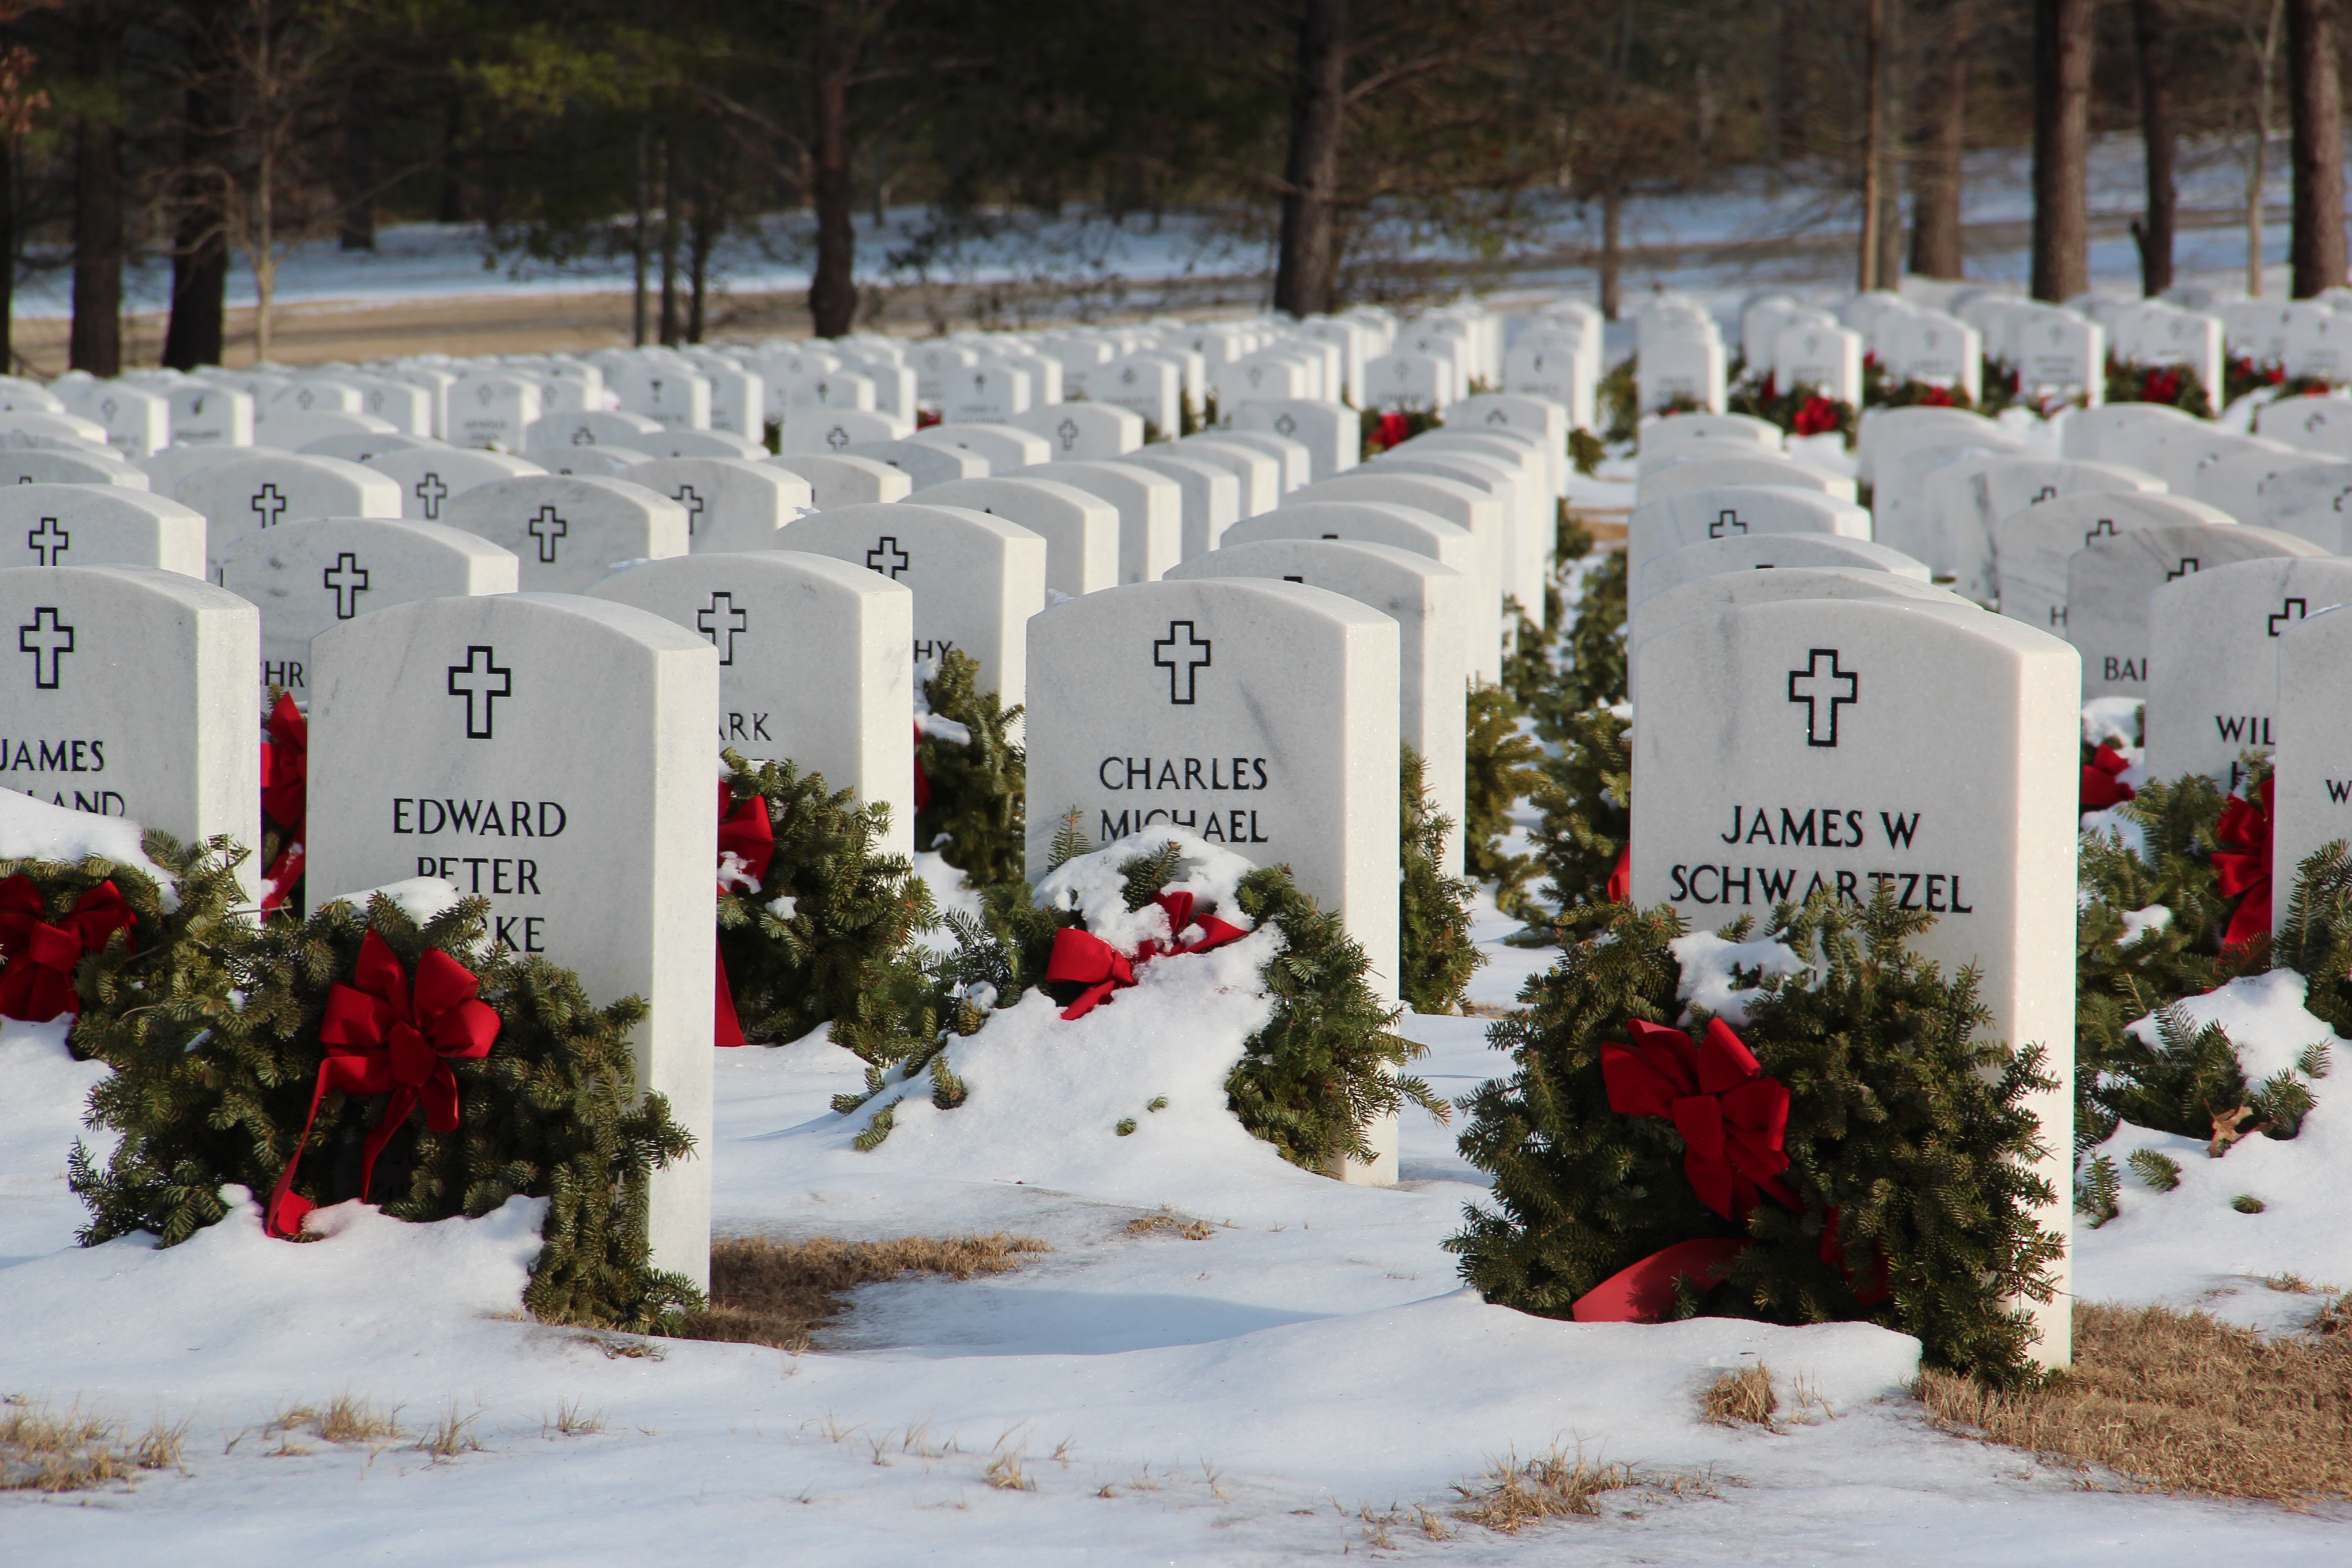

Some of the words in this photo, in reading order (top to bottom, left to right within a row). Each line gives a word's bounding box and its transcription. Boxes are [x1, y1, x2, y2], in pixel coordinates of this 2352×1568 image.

[260, 660, 305, 688] HR
[719, 713, 772, 741] RK
[0, 738, 104, 771] JAMES
[1099, 756, 1268, 790] CHARLES
[393, 798, 567, 837] EDWARD
[1720, 806, 1864, 848] JAMES
[1879, 811, 1921, 850] W
[417, 856, 541, 895] PETER
[478, 916, 546, 953] KE
